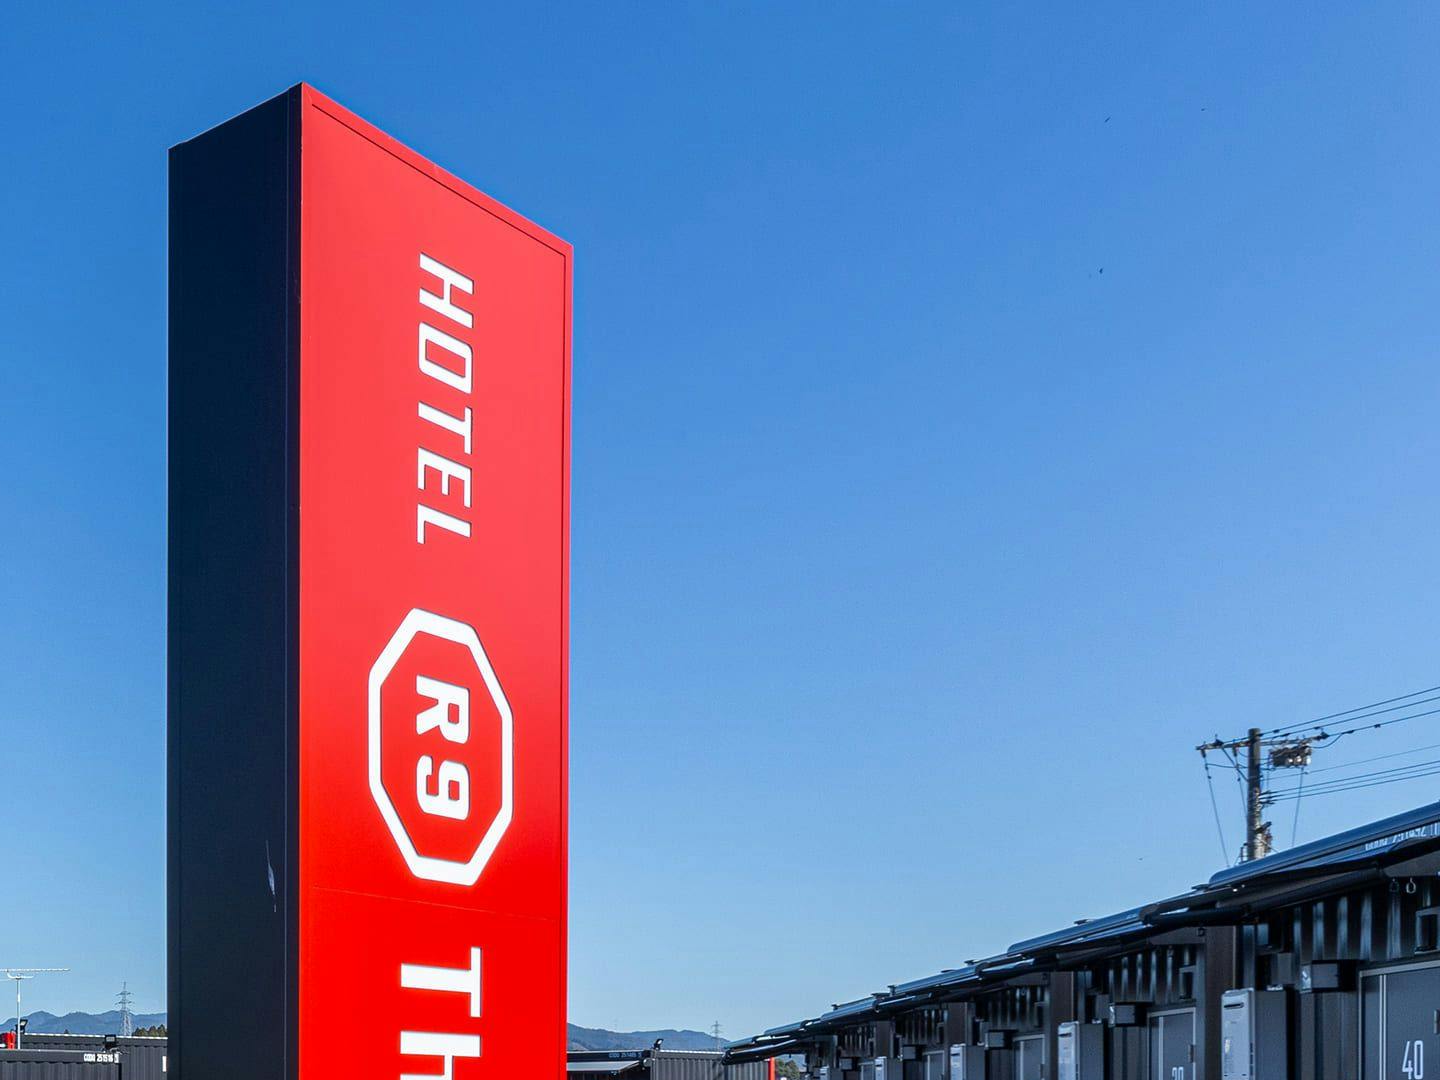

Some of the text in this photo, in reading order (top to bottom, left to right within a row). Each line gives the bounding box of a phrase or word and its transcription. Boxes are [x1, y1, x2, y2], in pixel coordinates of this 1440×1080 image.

[416, 252, 474, 546] HOTEL
[415, 675, 471, 822] R9
[1401, 1040, 1424, 1080] 40
